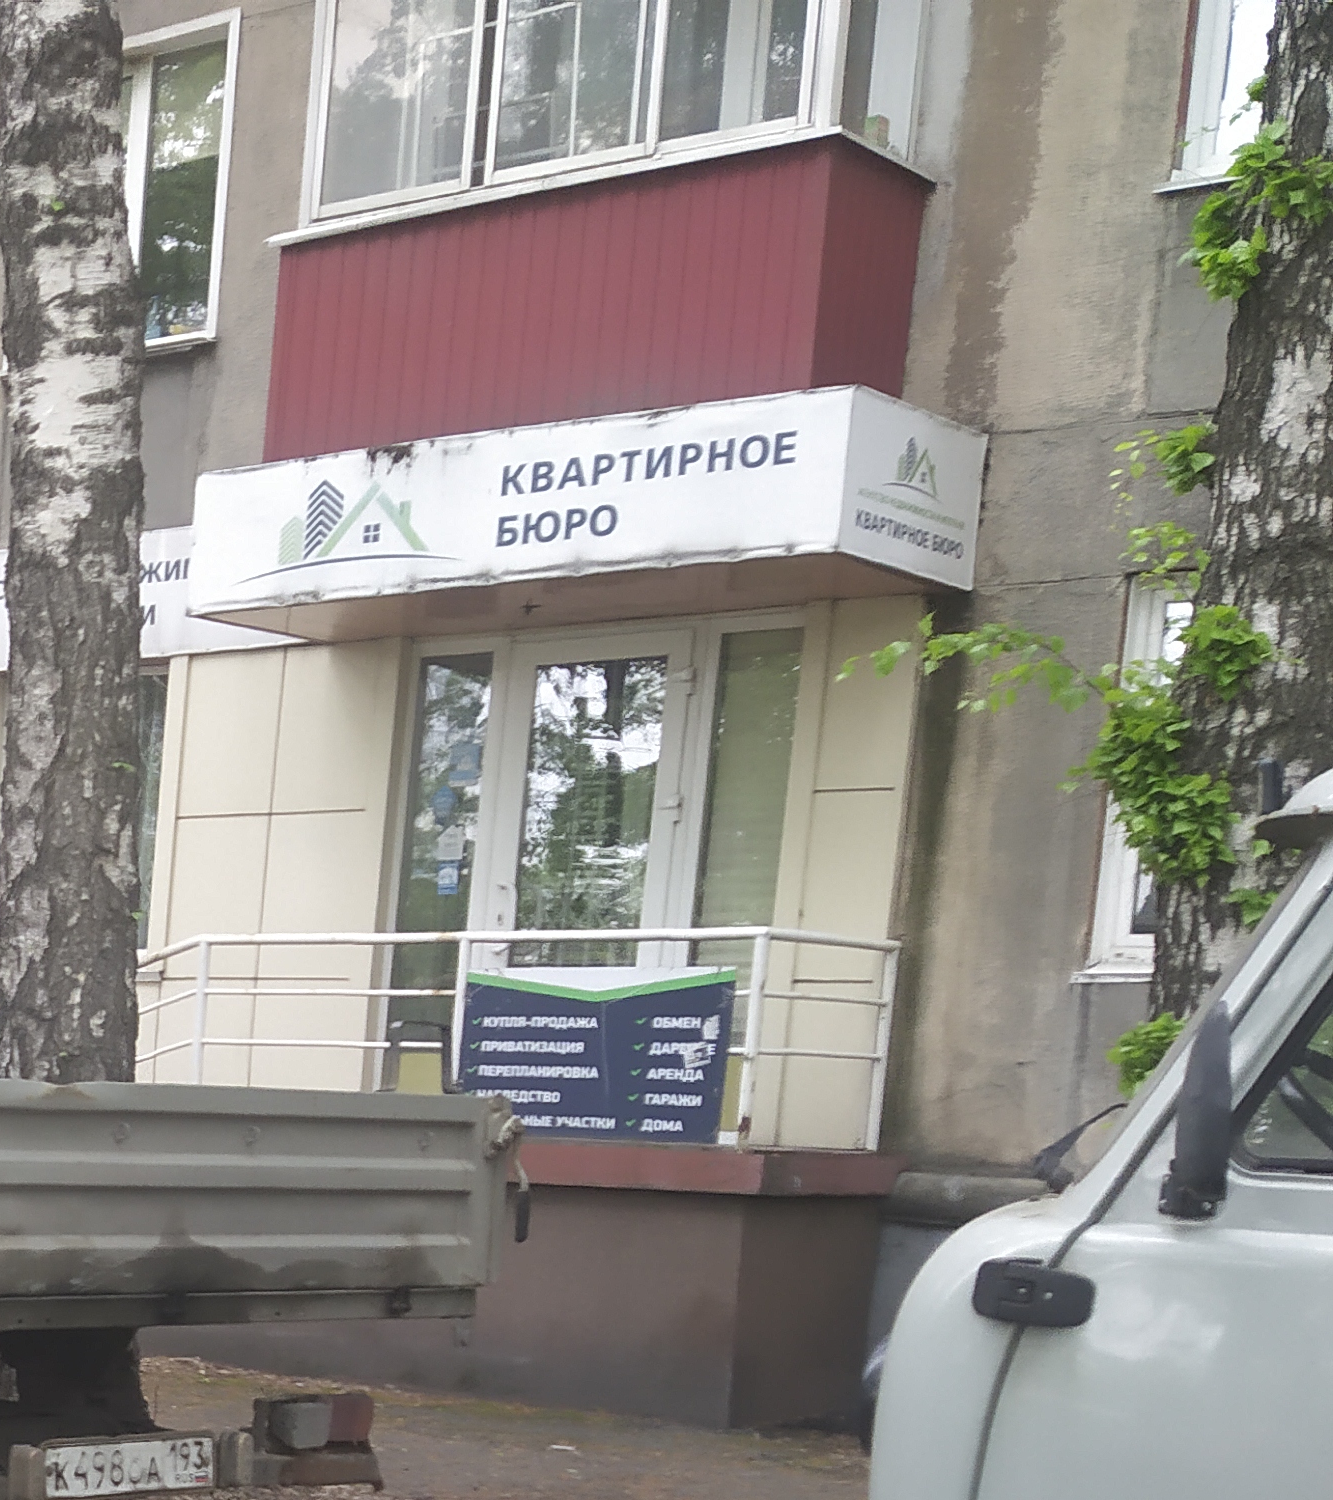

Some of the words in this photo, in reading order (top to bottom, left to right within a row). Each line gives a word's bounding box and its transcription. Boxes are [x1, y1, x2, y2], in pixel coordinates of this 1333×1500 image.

[501, 430, 798, 496] КВАРТИРНОЕ
[495, 504, 618, 547] БЮРО
[855, 508, 930, 548] КВАРТИРНОЕ
[931, 534, 964, 559] БЮРО
[482, 1016, 598, 1030] КУПЛЯ-ПРОДАЖА
[653, 1016, 702, 1029] ОБМЕН
[480, 1041, 585, 1054] ПРИВАТИЗАЦИЯ
[478, 1065, 599, 1079] ПЕРЕПЛАНИРОВКА
[646, 1067, 705, 1082] АРЕНДА
[644, 1093, 703, 1107] ГАРАЖИ
[556, 1115, 616, 1130] УЧАСТКИ
[639, 1117, 683, 1132] ДОМА
[169, 1440, 210, 1471] 193
